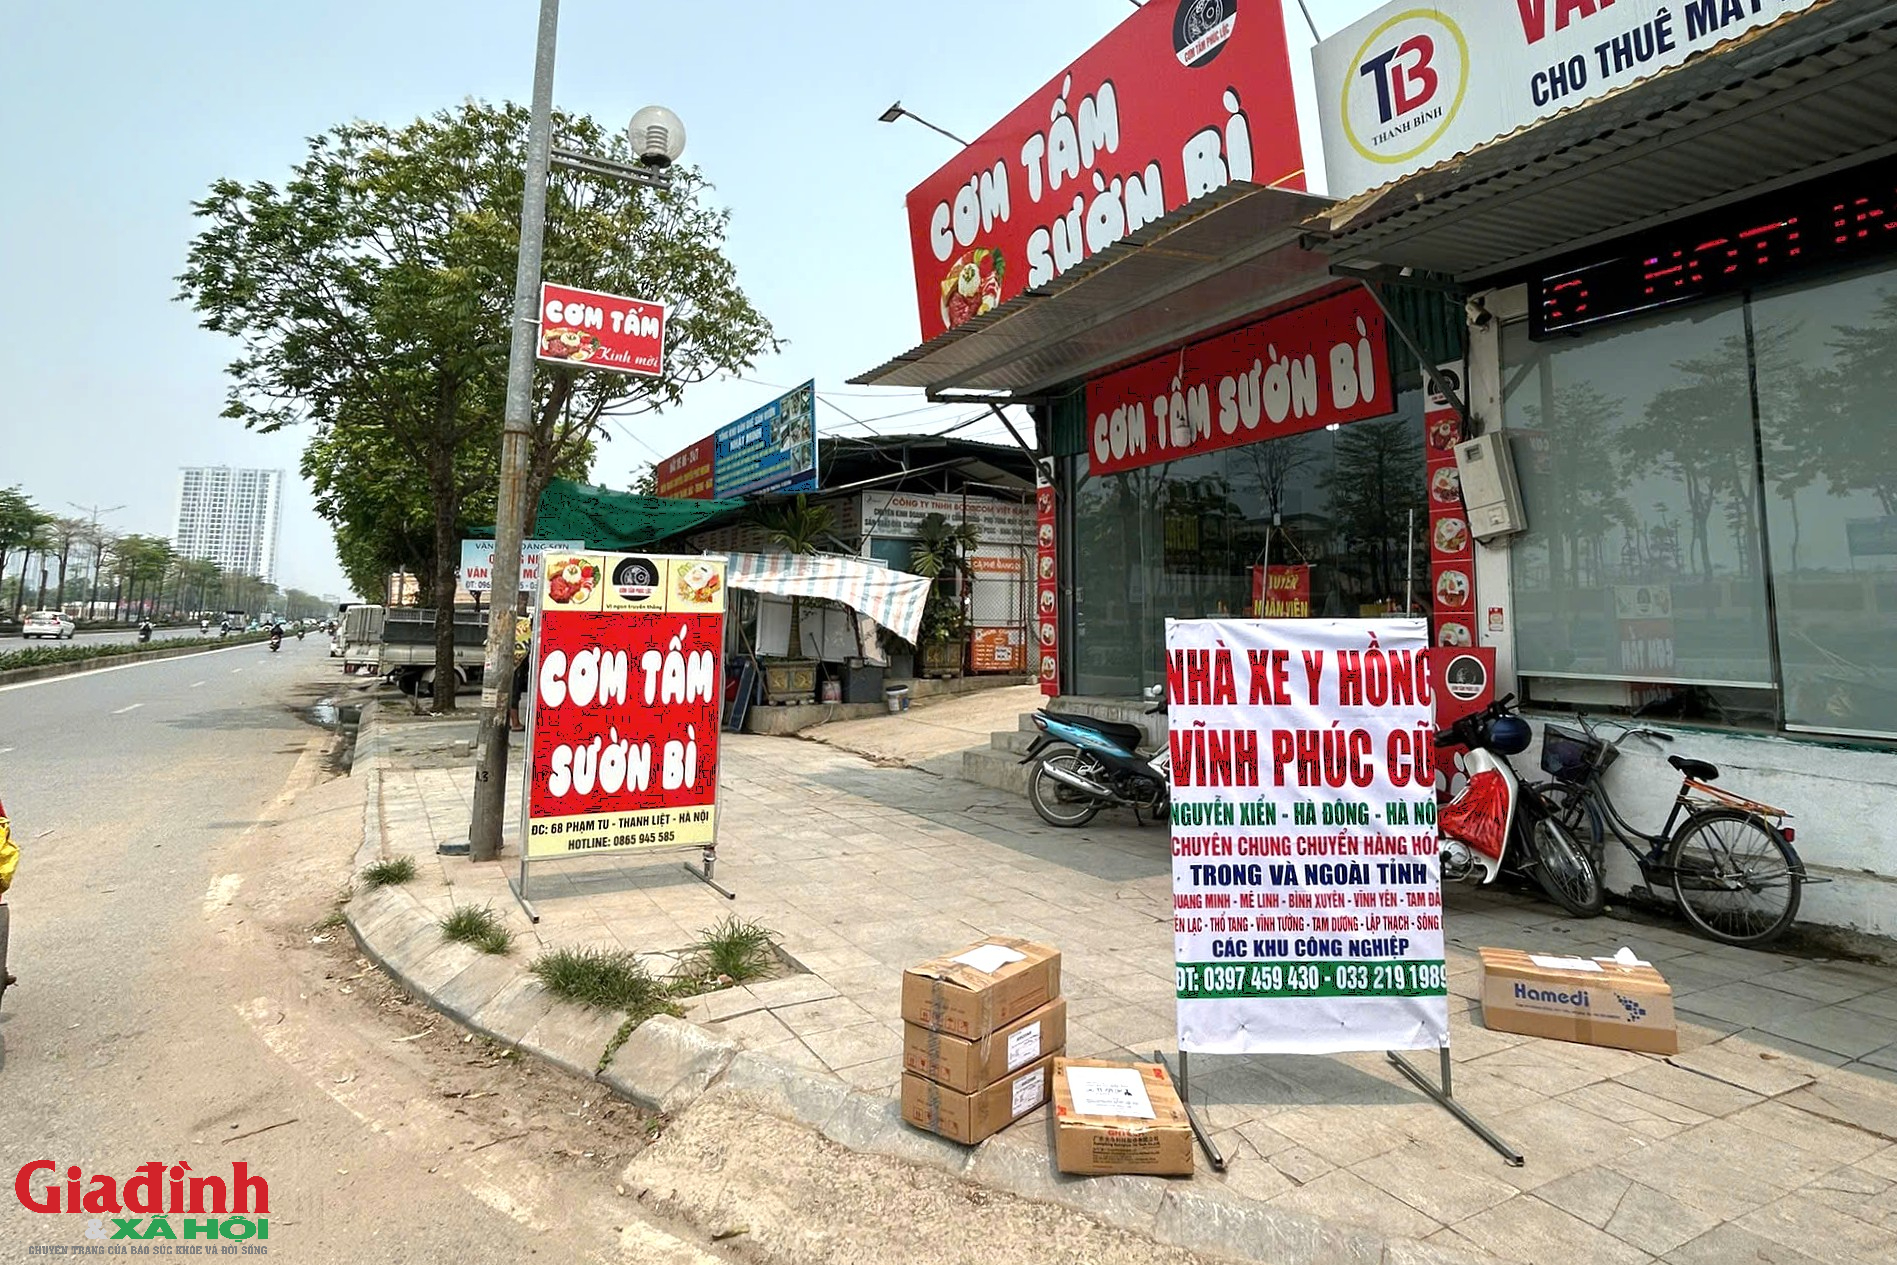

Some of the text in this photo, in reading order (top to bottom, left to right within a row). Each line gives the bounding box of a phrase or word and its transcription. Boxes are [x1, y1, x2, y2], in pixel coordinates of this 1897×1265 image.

[1532, 54, 1587, 107] CHO
[1594, 9, 1676, 79] THUÊ
[1371, 106, 1443, 147] THANH BÌNH
[930, 73, 1119, 262] CƠM TẤM
[1026, 90, 1254, 290] SƯỜN BÌ
[545, 300, 660, 340] CƠM TẤM
[1093, 402, 1147, 465] CƠM
[1218, 342, 1318, 435] SƯỜN
[1329, 315, 1376, 409] BÌ
[892, 496, 918, 507] CÔNG
[920, 500, 930, 508] TY
[931, 502, 952, 510] TNHH
[540, 623, 714, 708] CƠM TẤM
[1167, 640, 1238, 707] NHÀ
[1249, 649, 1292, 706] XE
[1302, 649, 1325, 706] Y
[548, 724, 697, 798] SƯỜN BÌ
[1168, 720, 1436, 789] VĨNH PHÚC CŨ
[531, 810, 710, 836] ĐC: 68 PHẠM TU THANH LIỆT HÀ NỘI
[1169, 794, 1235, 827] NGUYỄN
[1239, 793, 1278, 827] XIỂN
[1293, 797, 1318, 826] HÀ
[1321, 796, 1370, 826] ĐÔNG
[1386, 796, 1410, 826] HÀ
[568, 831, 675, 851] HOTLINE: 0865 945 585
[1172, 833, 1233, 857] CHUYÊN
[1237, 836, 1291, 857] CHUNG
[1296, 827, 1359, 857] CHUYỂN
[1364, 833, 1407, 856] HÀNG
[1190, 857, 1427, 887] TRONG VÀ NGOÀI TỈNH
[1205, 893, 1231, 909] MINH
[1240, 891, 1255, 908] MÊ
[1257, 892, 1280, 909] LINH
[1288, 890, 1312, 909] BÌNH
[1314, 889, 1345, 909] XUYÊN
[1354, 890, 1376, 907] VĨNH
[1378, 889, 1398, 907] YÊN
[1406, 891, 1426, 907] TAM
[1187, 917, 1203, 936] LẠC
[1210, 911, 1226, 932] THỔ
[1228, 915, 1249, 932] TANG
[1256, 914, 1276, 932] VĨNH
[1277, 913, 1305, 932] TƯỜNG
[1312, 916, 1329, 932] TAM
[1331, 915, 1359, 932] DƯƠNG
[1365, 913, 1382, 935] LẬP
[1383, 915, 1409, 934] THẠCH
[1417, 913, 1439, 930] SÔNG
[1212, 935, 1409, 959] CÁC KHU CÔNG NGHIỆP
[1177, 967, 1199, 992] ĐT:
[1203, 966, 1245, 991] 0397
[1251, 966, 1283, 990] 459
[1288, 965, 1319, 990] 430
[1336, 965, 1368, 990] 033
[1373, 965, 1405, 989] 219
[1514, 982, 1590, 1008] Hamedi
